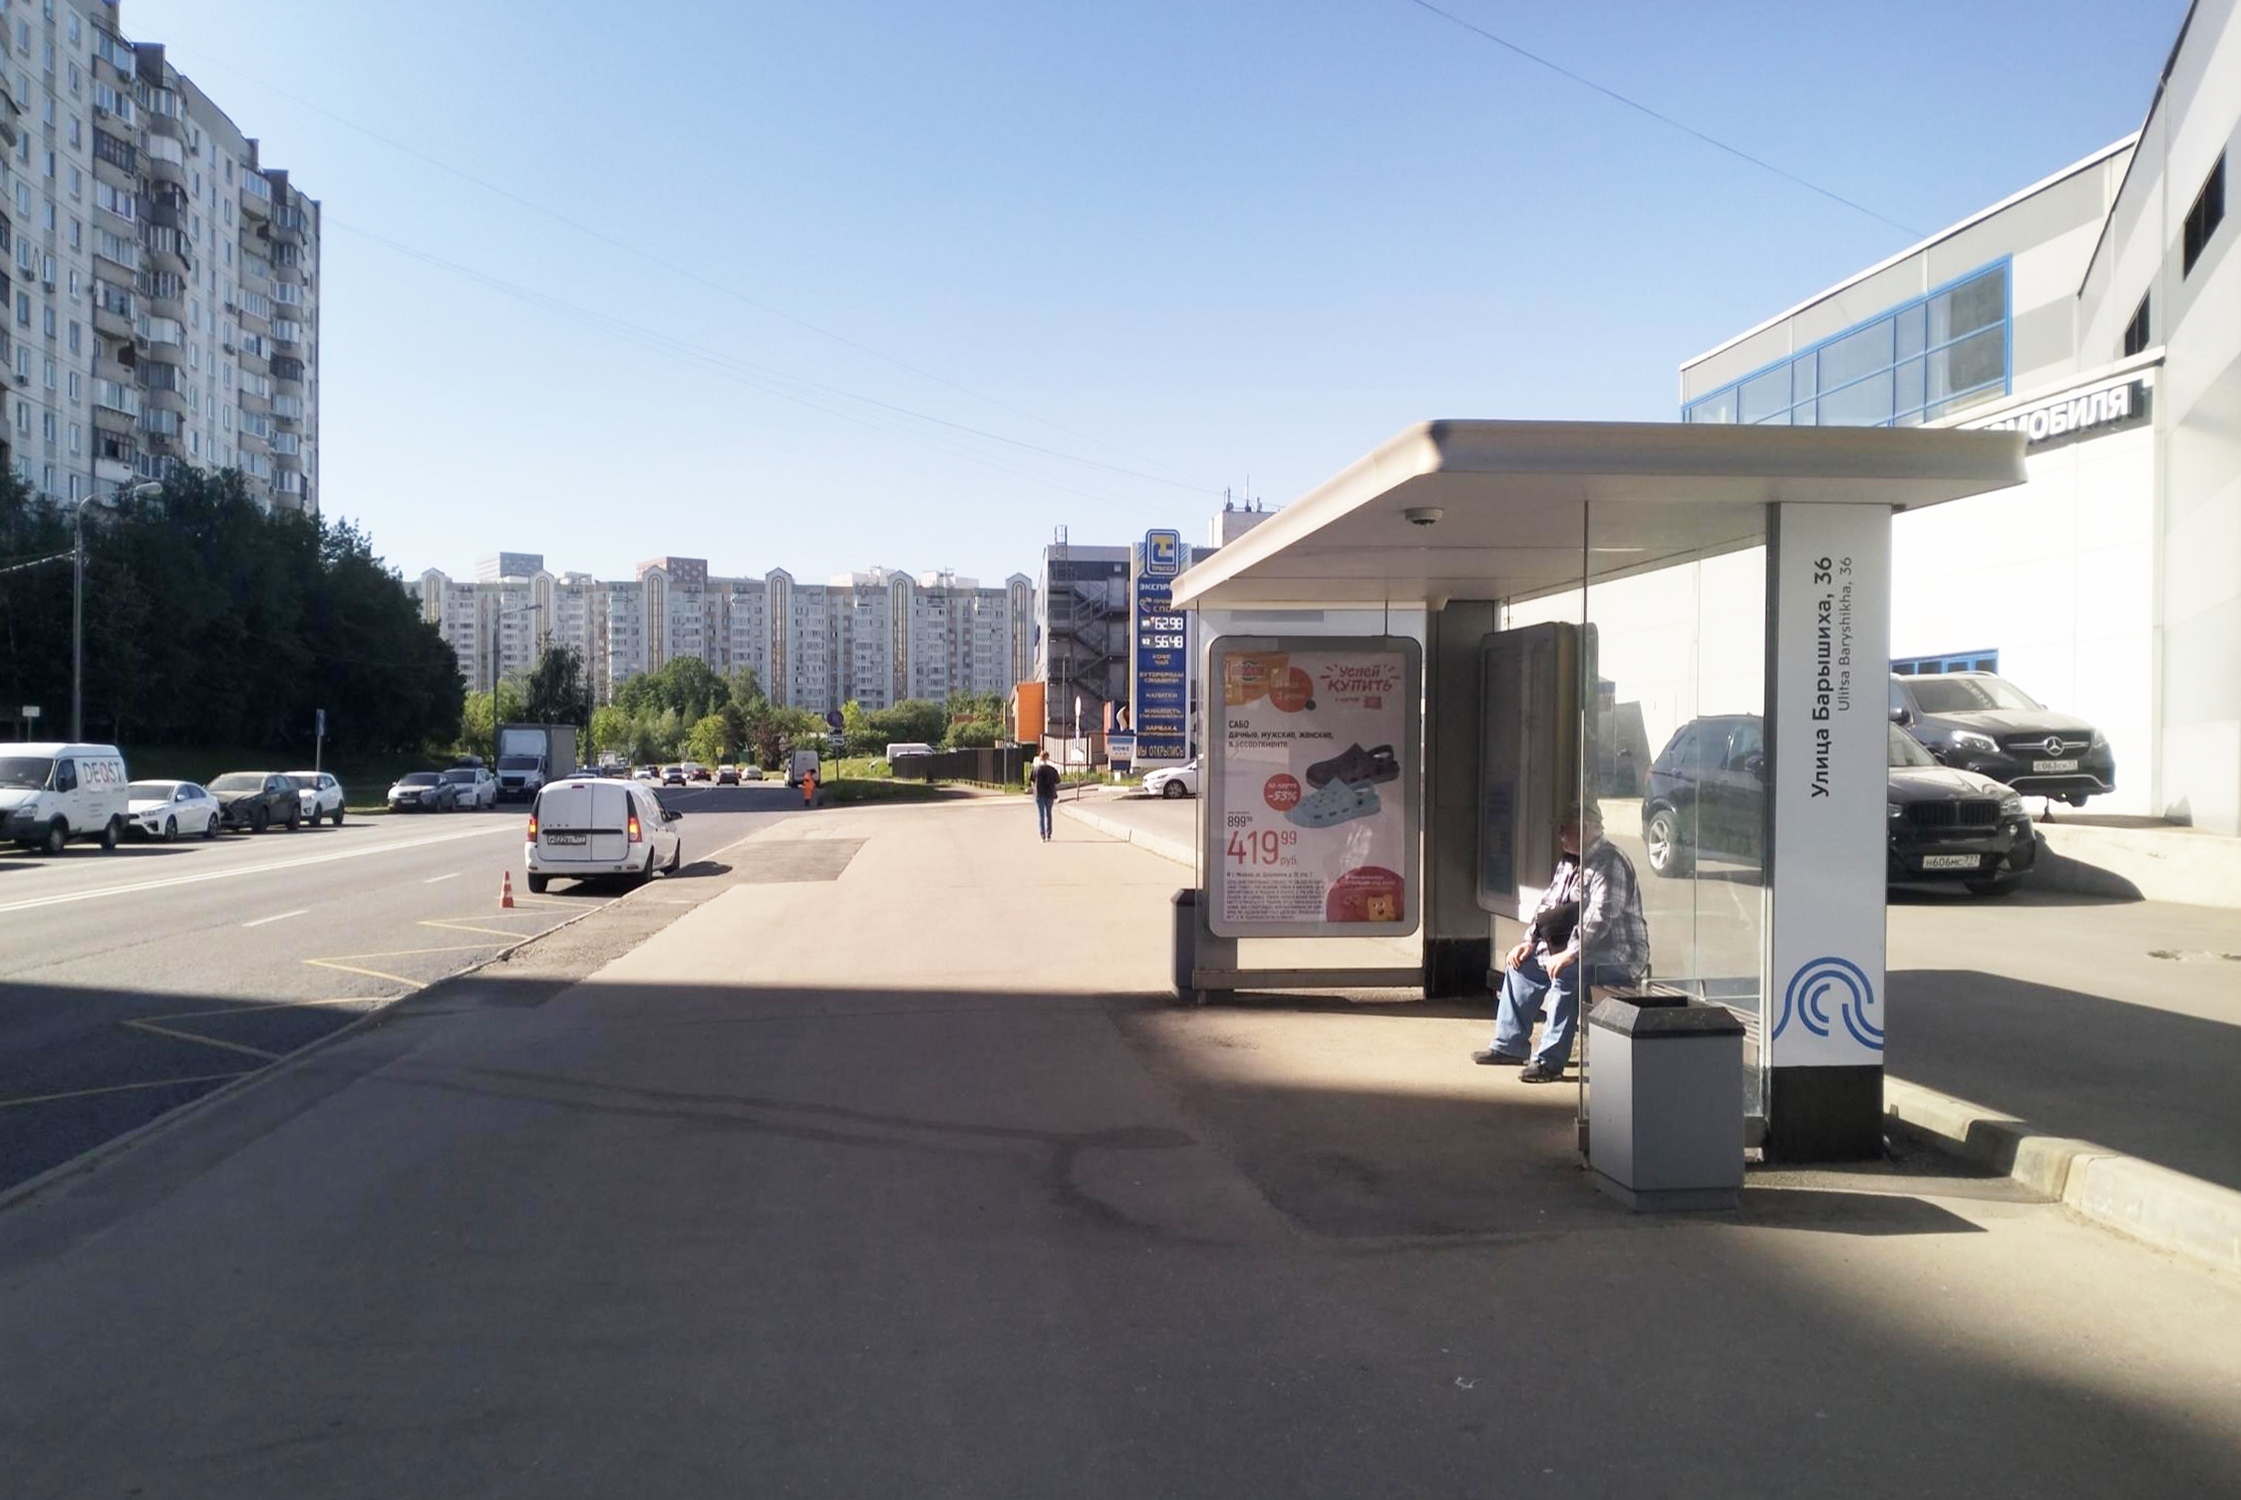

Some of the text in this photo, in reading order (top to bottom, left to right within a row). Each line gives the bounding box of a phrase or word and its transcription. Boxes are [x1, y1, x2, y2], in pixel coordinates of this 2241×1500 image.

[1986, 385, 2130, 440] МОБИЛЯ
[1139, 583, 1171, 591] ЭКСПР
[1838, 556, 1853, 711] Ulitsa Baryshikha, 36
[1812, 556, 1835, 798] Улица Барышиха, 36
[1228, 719, 1250, 729] САБО
